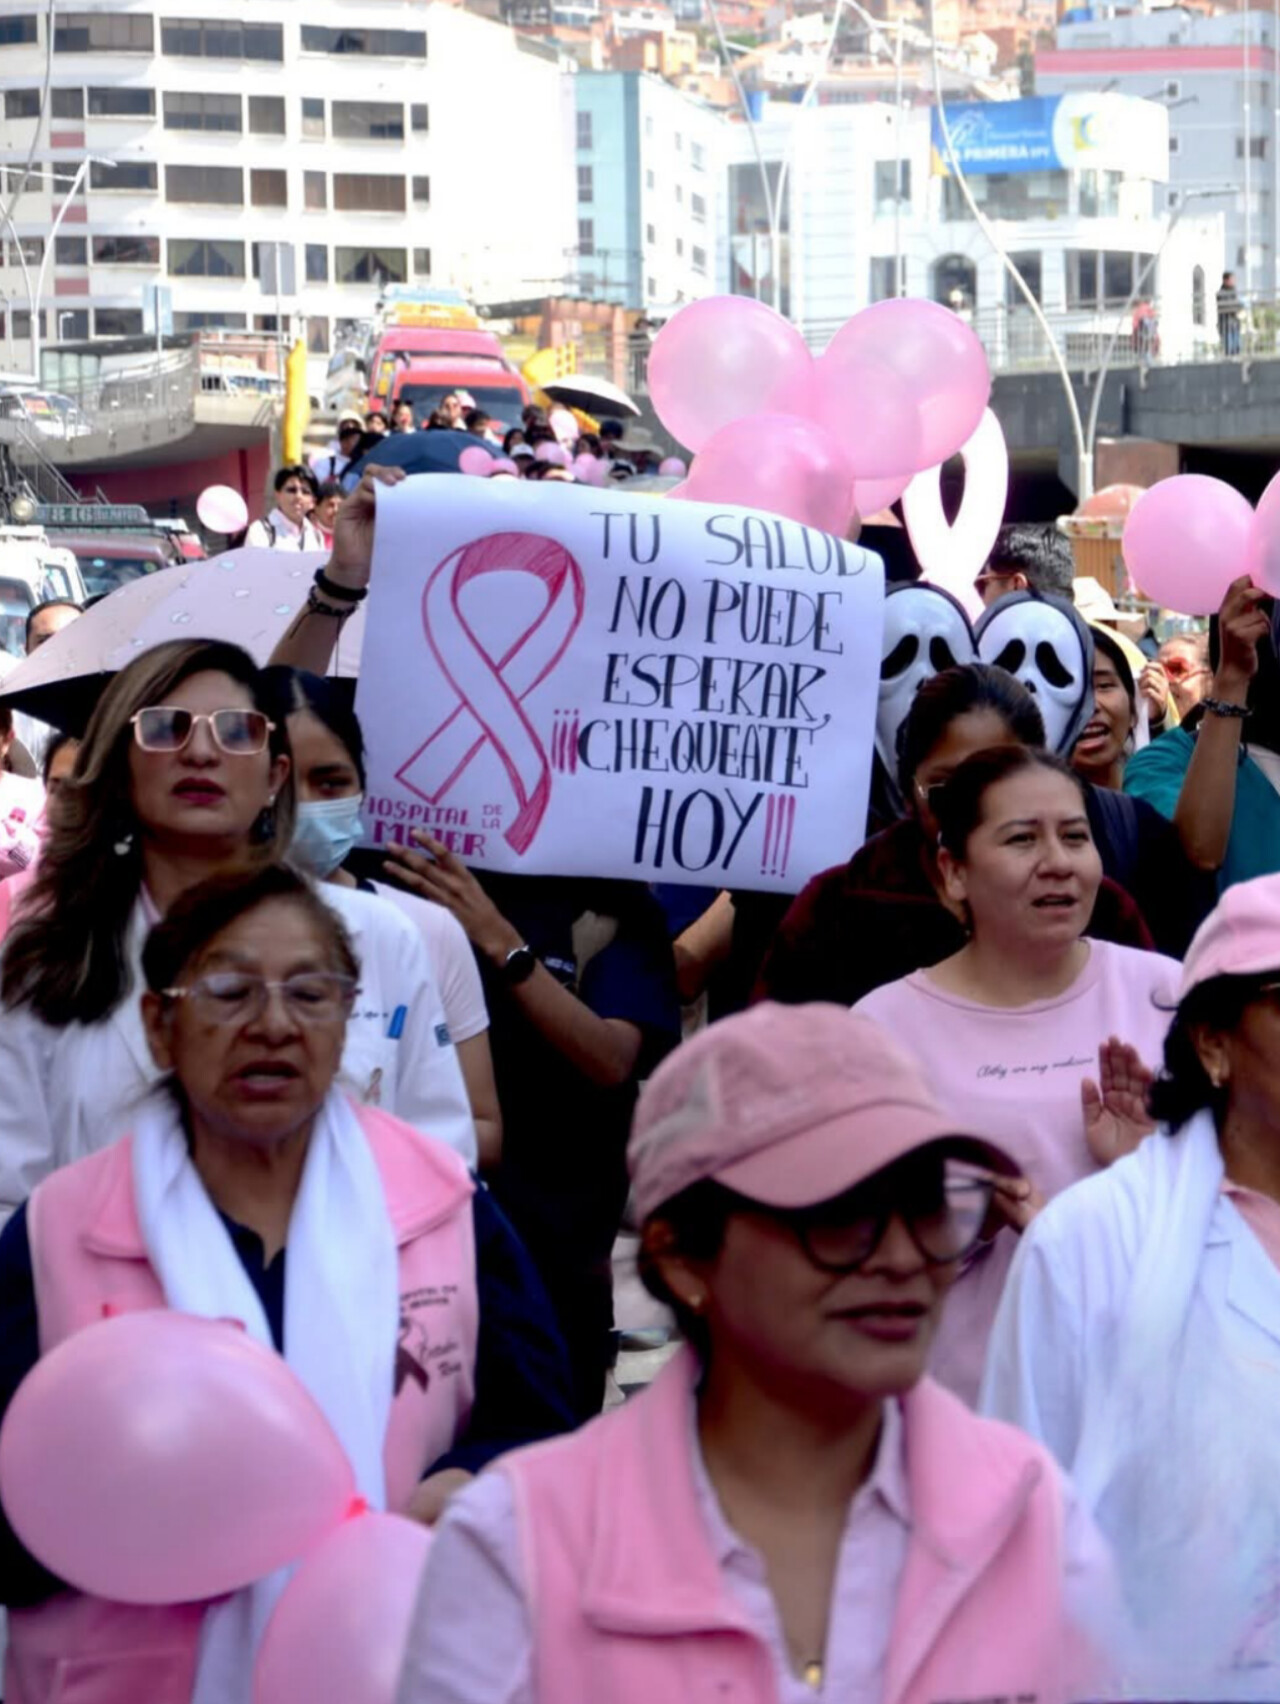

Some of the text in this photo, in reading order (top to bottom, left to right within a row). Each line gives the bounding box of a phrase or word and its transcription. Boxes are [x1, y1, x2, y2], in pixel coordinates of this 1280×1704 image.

[589, 512, 867, 577] TU SALUD
[608, 575, 844, 656] NO PUEDE
[481, 818, 501, 830] LA
[482, 804, 503, 817] DE
